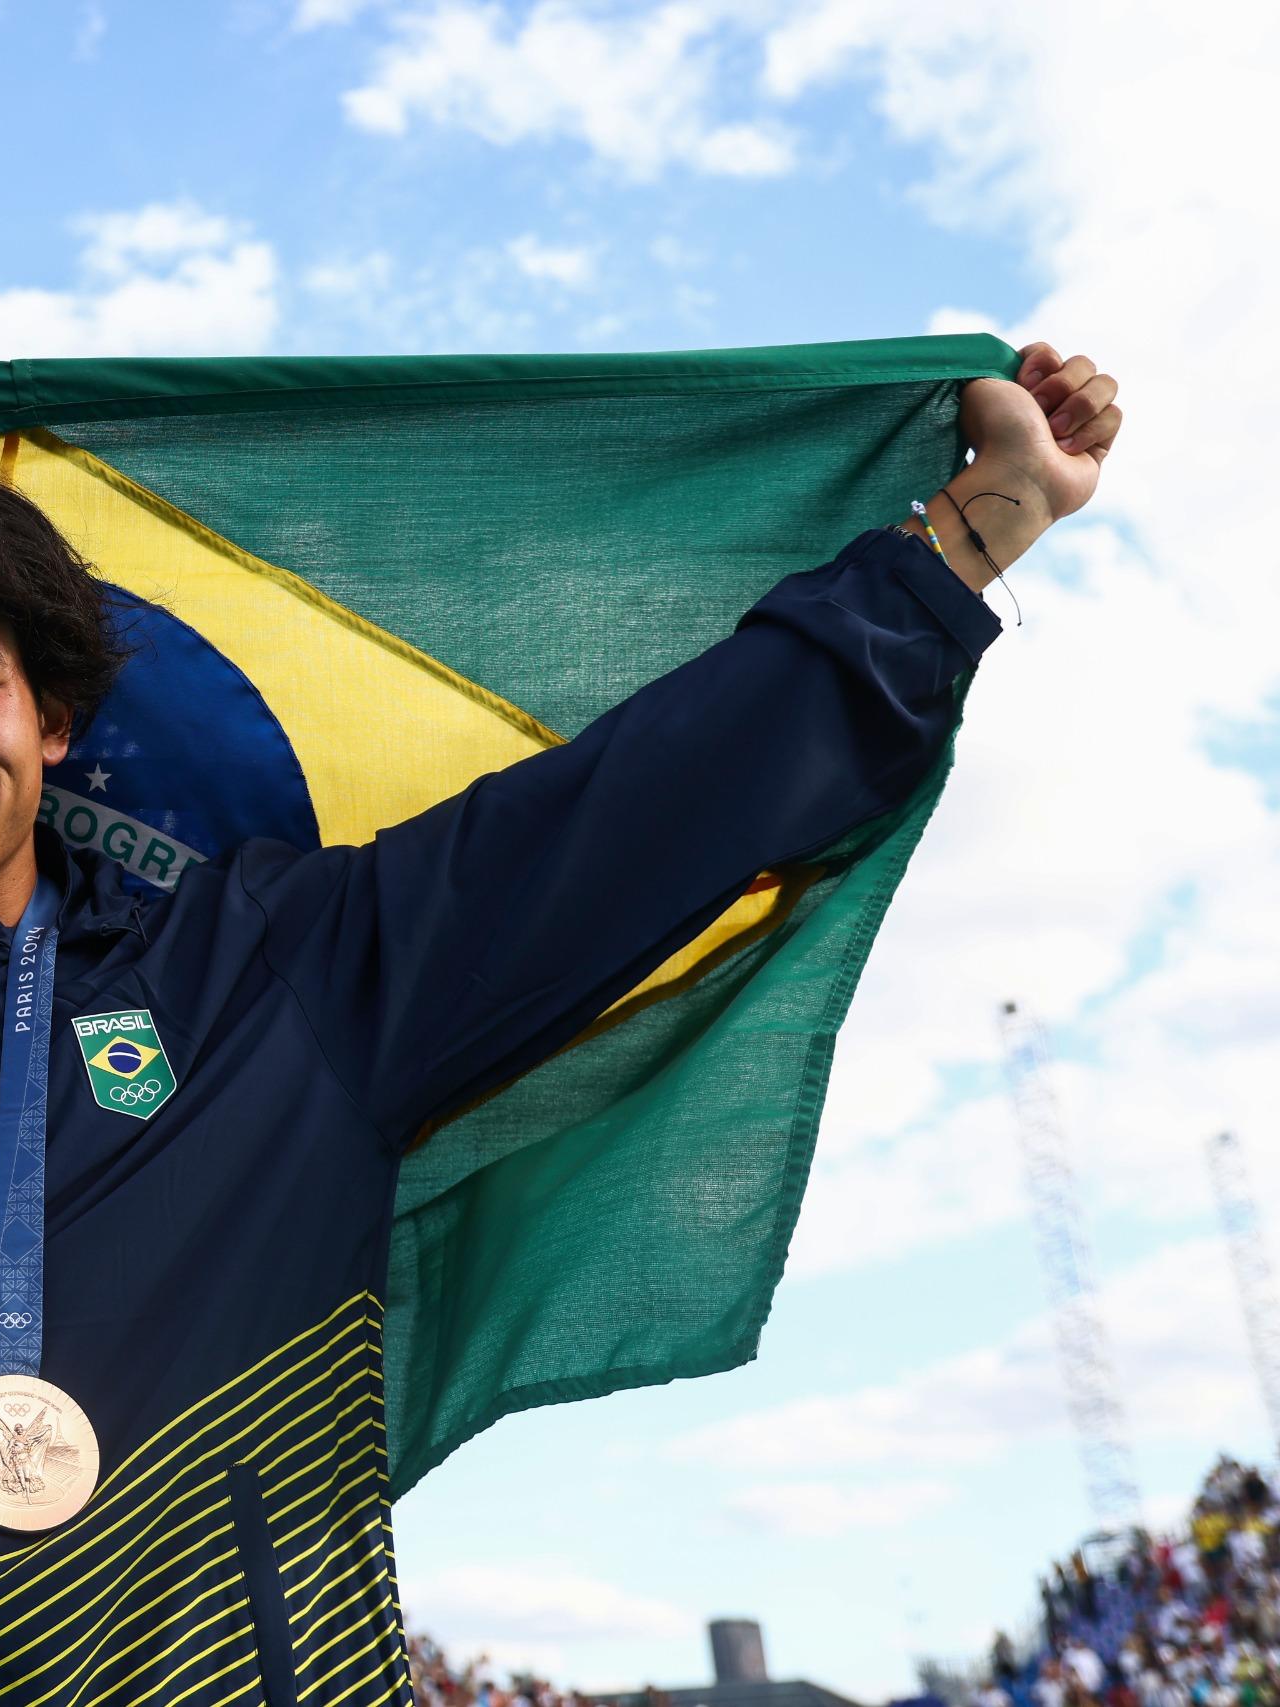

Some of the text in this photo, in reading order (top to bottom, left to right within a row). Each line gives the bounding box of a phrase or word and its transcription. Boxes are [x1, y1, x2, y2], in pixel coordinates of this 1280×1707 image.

[36, 791, 200, 889] ROGR
[20, 926, 45, 966] 2024
[75, 1015, 152, 1037] BRASIL
